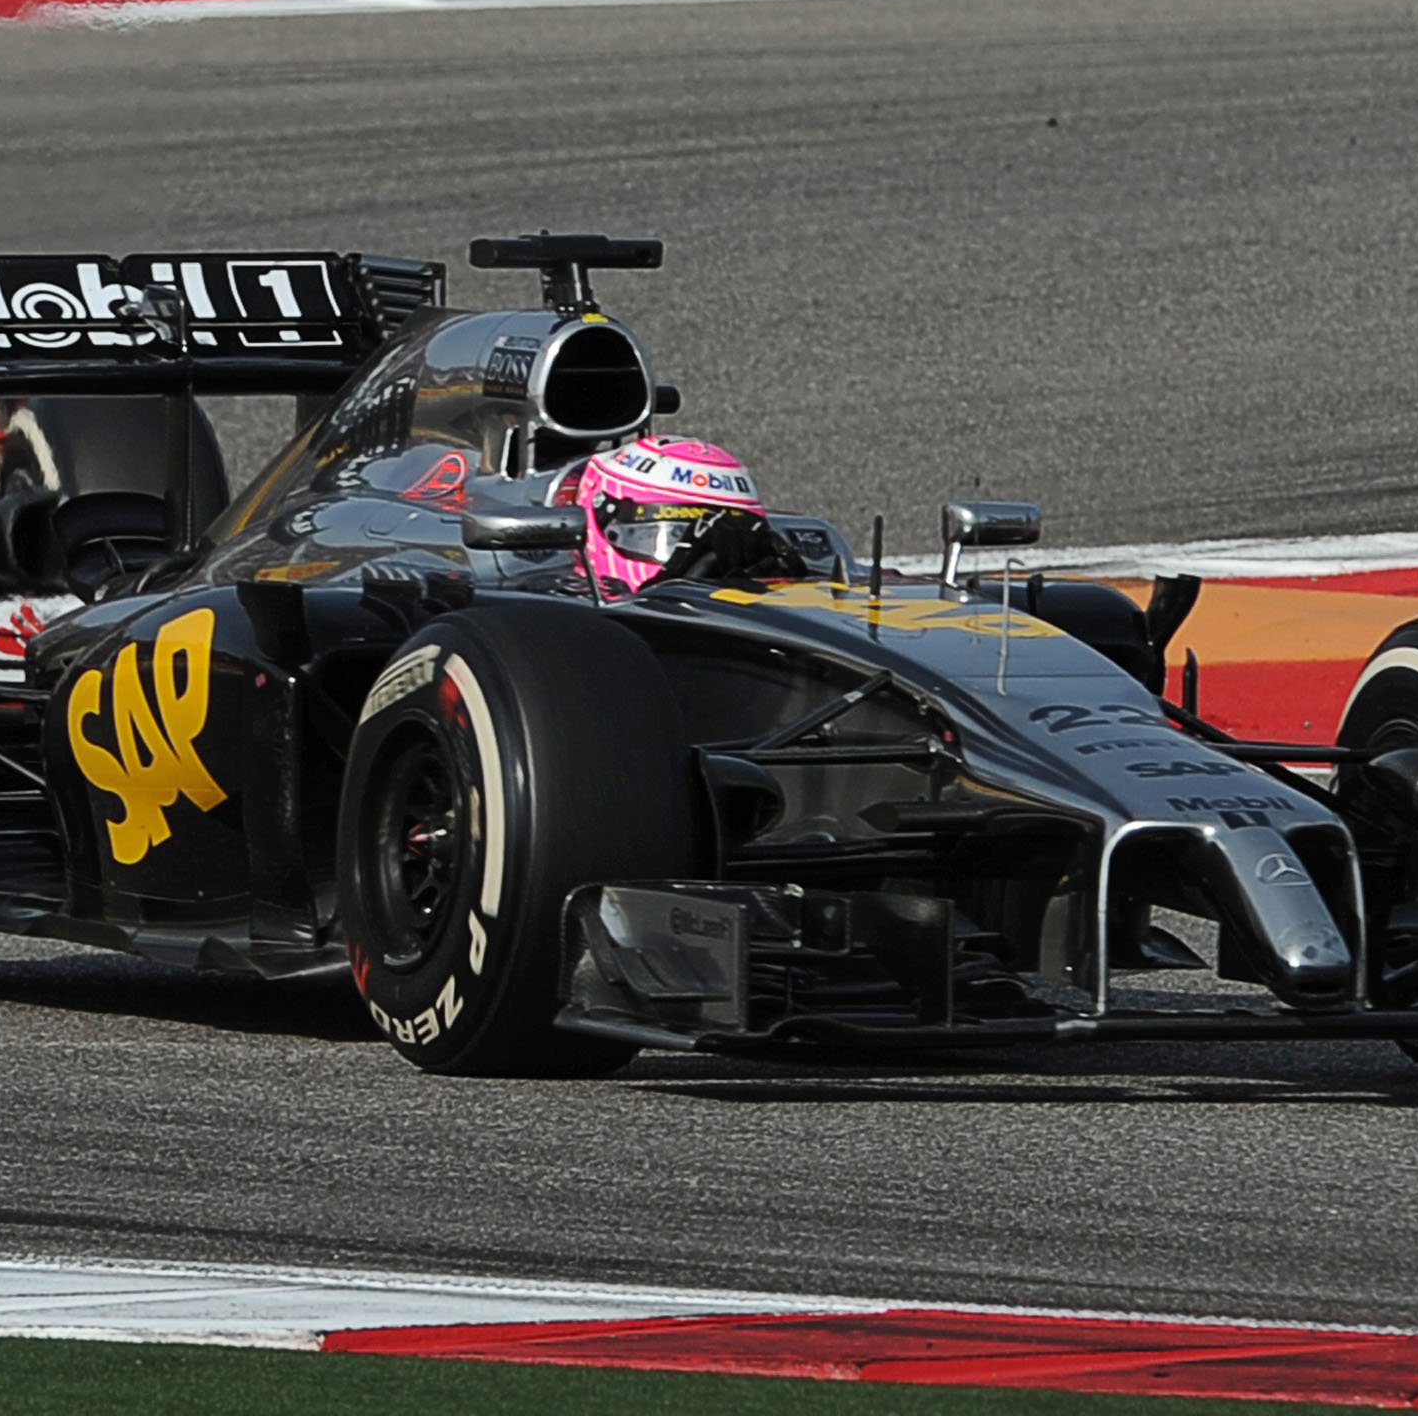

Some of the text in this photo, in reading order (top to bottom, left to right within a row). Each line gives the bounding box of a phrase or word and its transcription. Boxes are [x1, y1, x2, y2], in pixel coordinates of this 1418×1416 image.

[487, 352, 532, 384] BOSS
[671, 466, 750, 494] Mobil 1
[1029, 703, 1170, 734] 22
[67, 607, 229, 865] SAP
[1126, 760, 1247, 779] SAP
[1166, 795, 1296, 813] Mobil
[369, 908, 487, 1046] P ZERO
